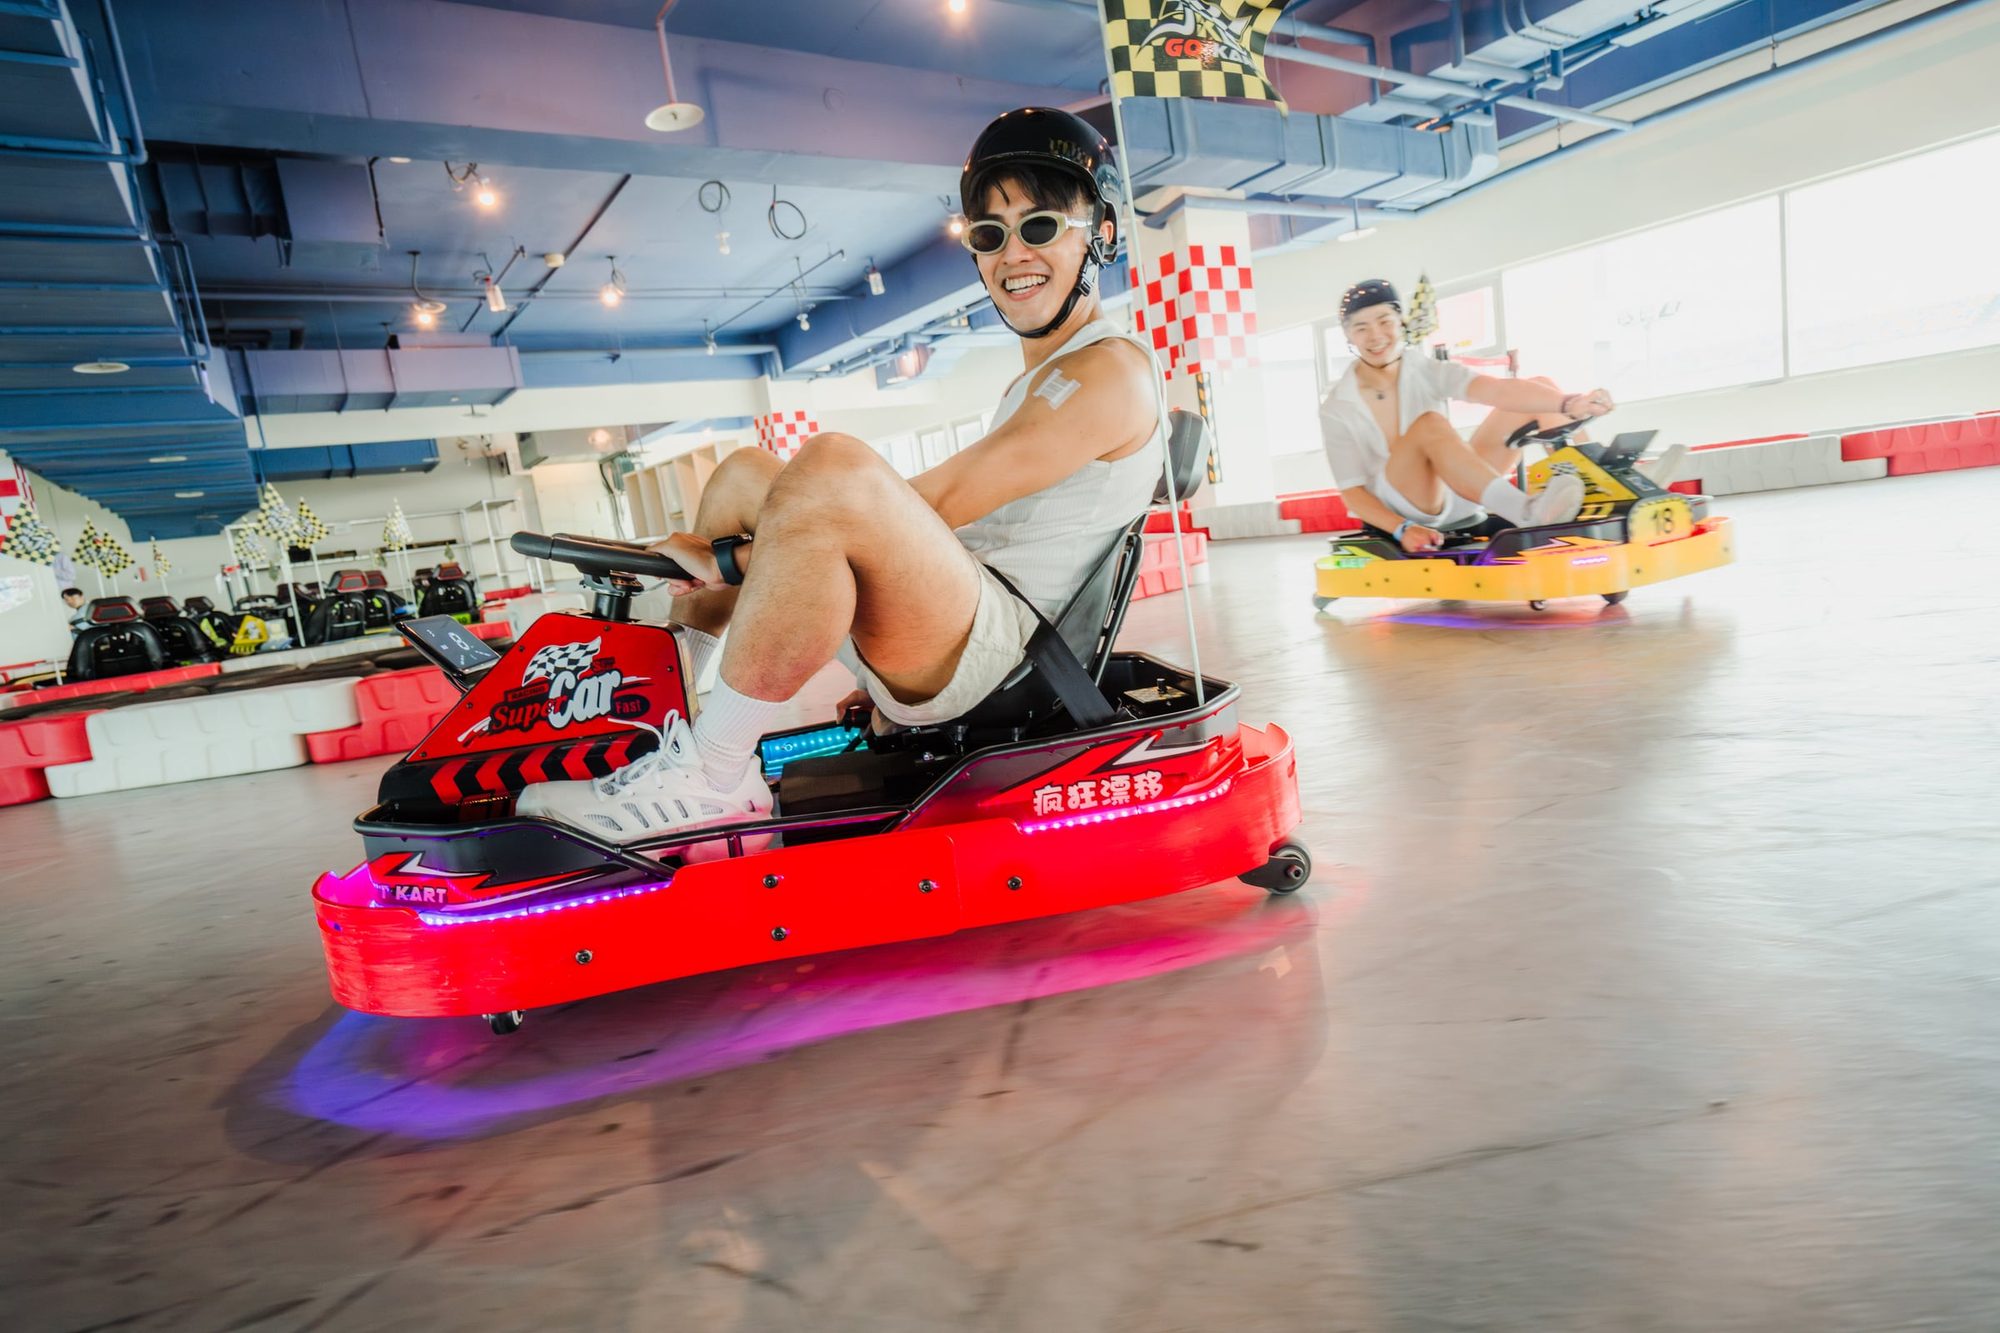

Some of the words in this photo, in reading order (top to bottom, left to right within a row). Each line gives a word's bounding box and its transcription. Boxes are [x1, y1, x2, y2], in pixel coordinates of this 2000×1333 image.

[1651, 507, 1673, 536] 18
[493, 695, 568, 730] Super
[548, 670, 622, 729] Car
[615, 699, 642, 714] Fast
[1032, 770, 1164, 816] 疯狂漂移
[395, 885, 447, 903] KART
